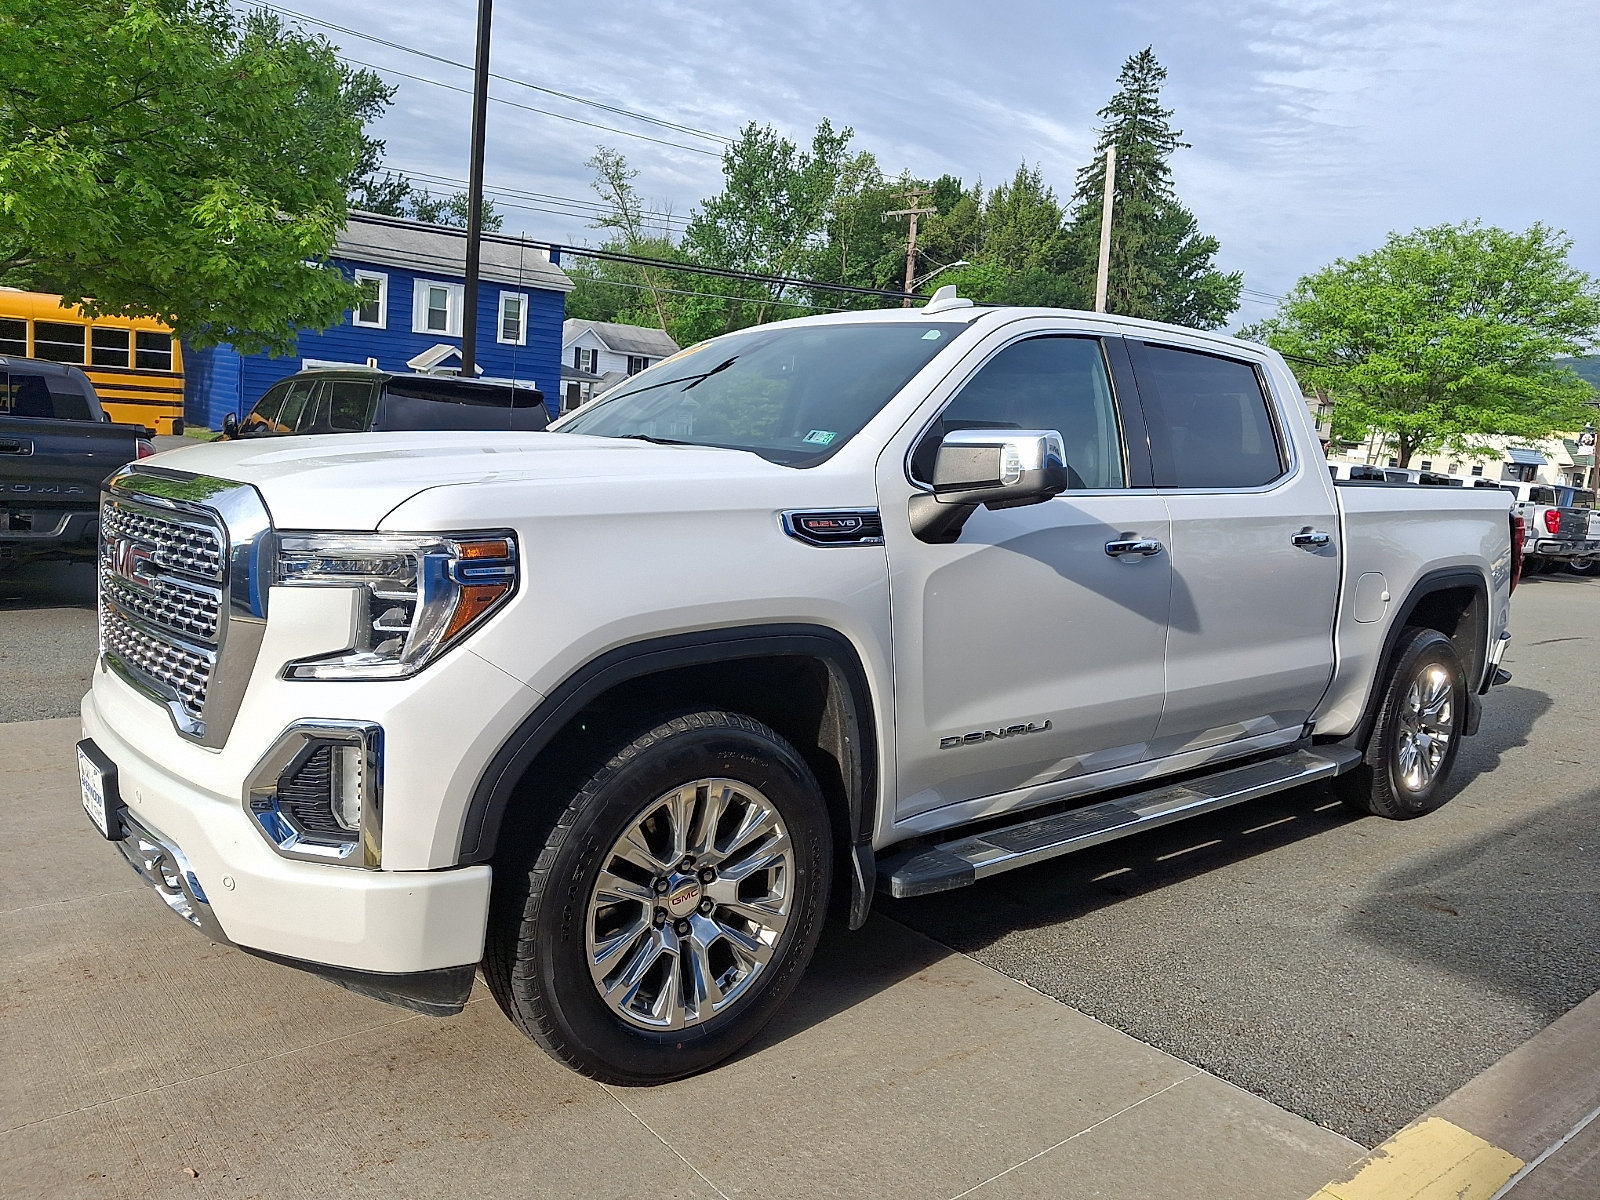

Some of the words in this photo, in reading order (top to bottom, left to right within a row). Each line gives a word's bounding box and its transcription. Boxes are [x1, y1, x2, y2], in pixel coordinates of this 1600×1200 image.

[106, 536, 156, 591] GMC
[939, 719, 1053, 750] DENALI
[671, 888, 699, 906] GMC
